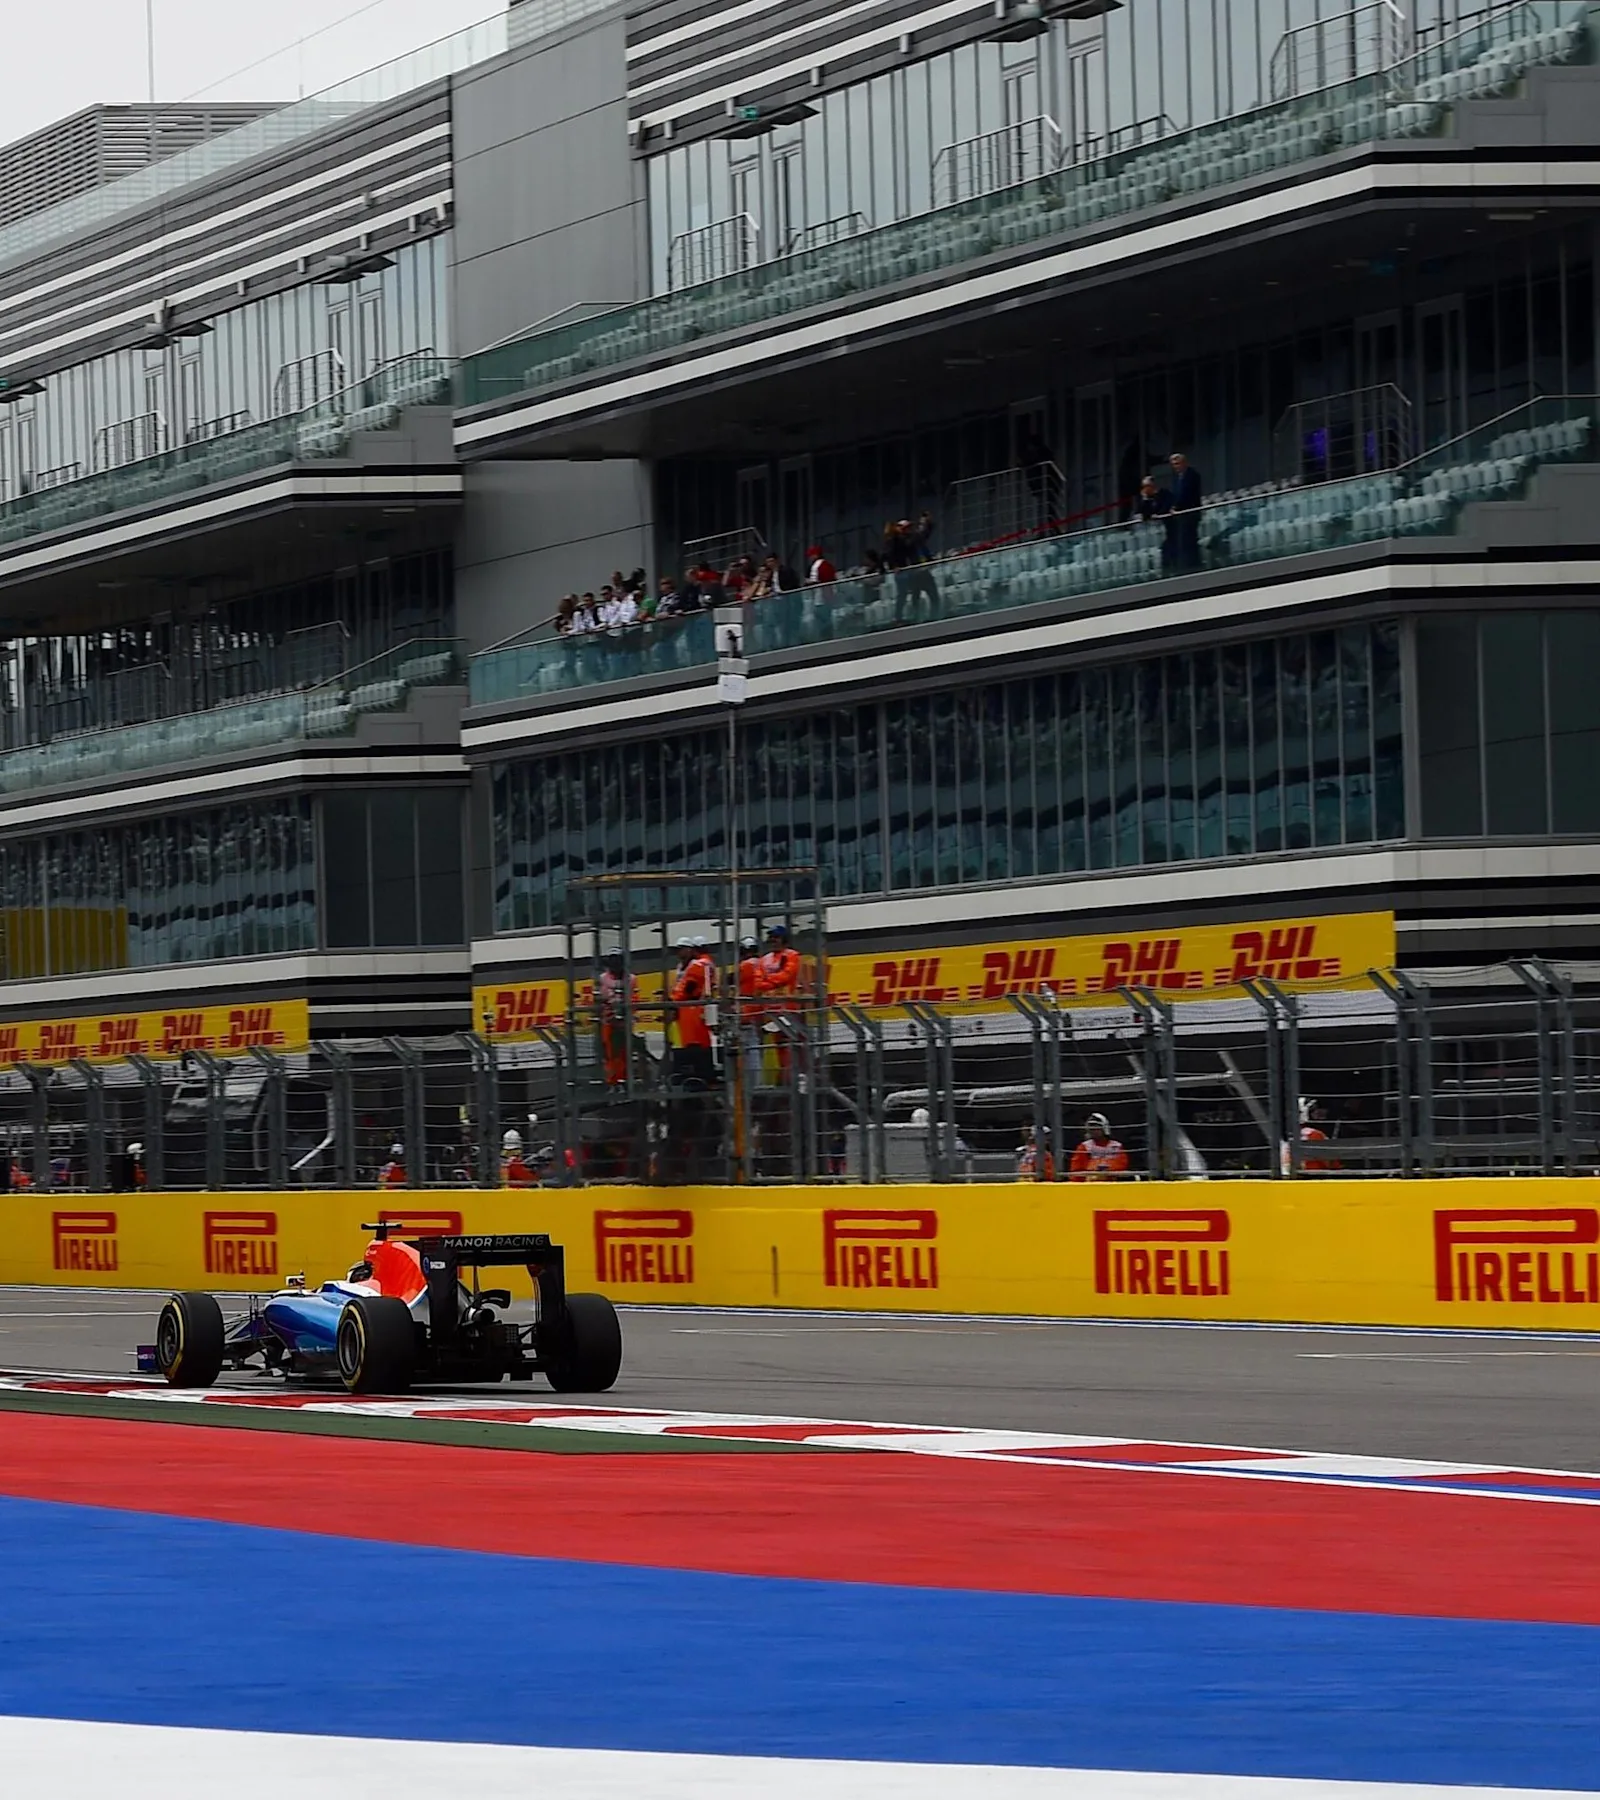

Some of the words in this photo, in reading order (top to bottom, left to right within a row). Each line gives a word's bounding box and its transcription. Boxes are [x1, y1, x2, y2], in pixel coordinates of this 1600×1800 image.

[495, 988, 551, 1032] DHL
[872, 958, 946, 1005] DHL
[982, 948, 1061, 1000] DHL
[1102, 939, 1186, 992] DHL
[1231, 926, 1321, 983] DHL
[38, 1024, 78, 1059] DHL
[99, 1019, 141, 1055] DHL
[161, 1014, 206, 1051] DHL
[227, 1008, 274, 1048] DHL
[52, 1211, 117, 1271] PIRELLI
[204, 1211, 277, 1274] PIRELLI
[594, 1209, 693, 1283] PIRELLI
[823, 1209, 938, 1288] PIRELLI
[1093, 1209, 1230, 1296] PIRELLI
[1433, 1208, 1600, 1303] PIRELLI
[444, 1237, 492, 1247] MANOR
[495, 1236, 544, 1246] RACING
